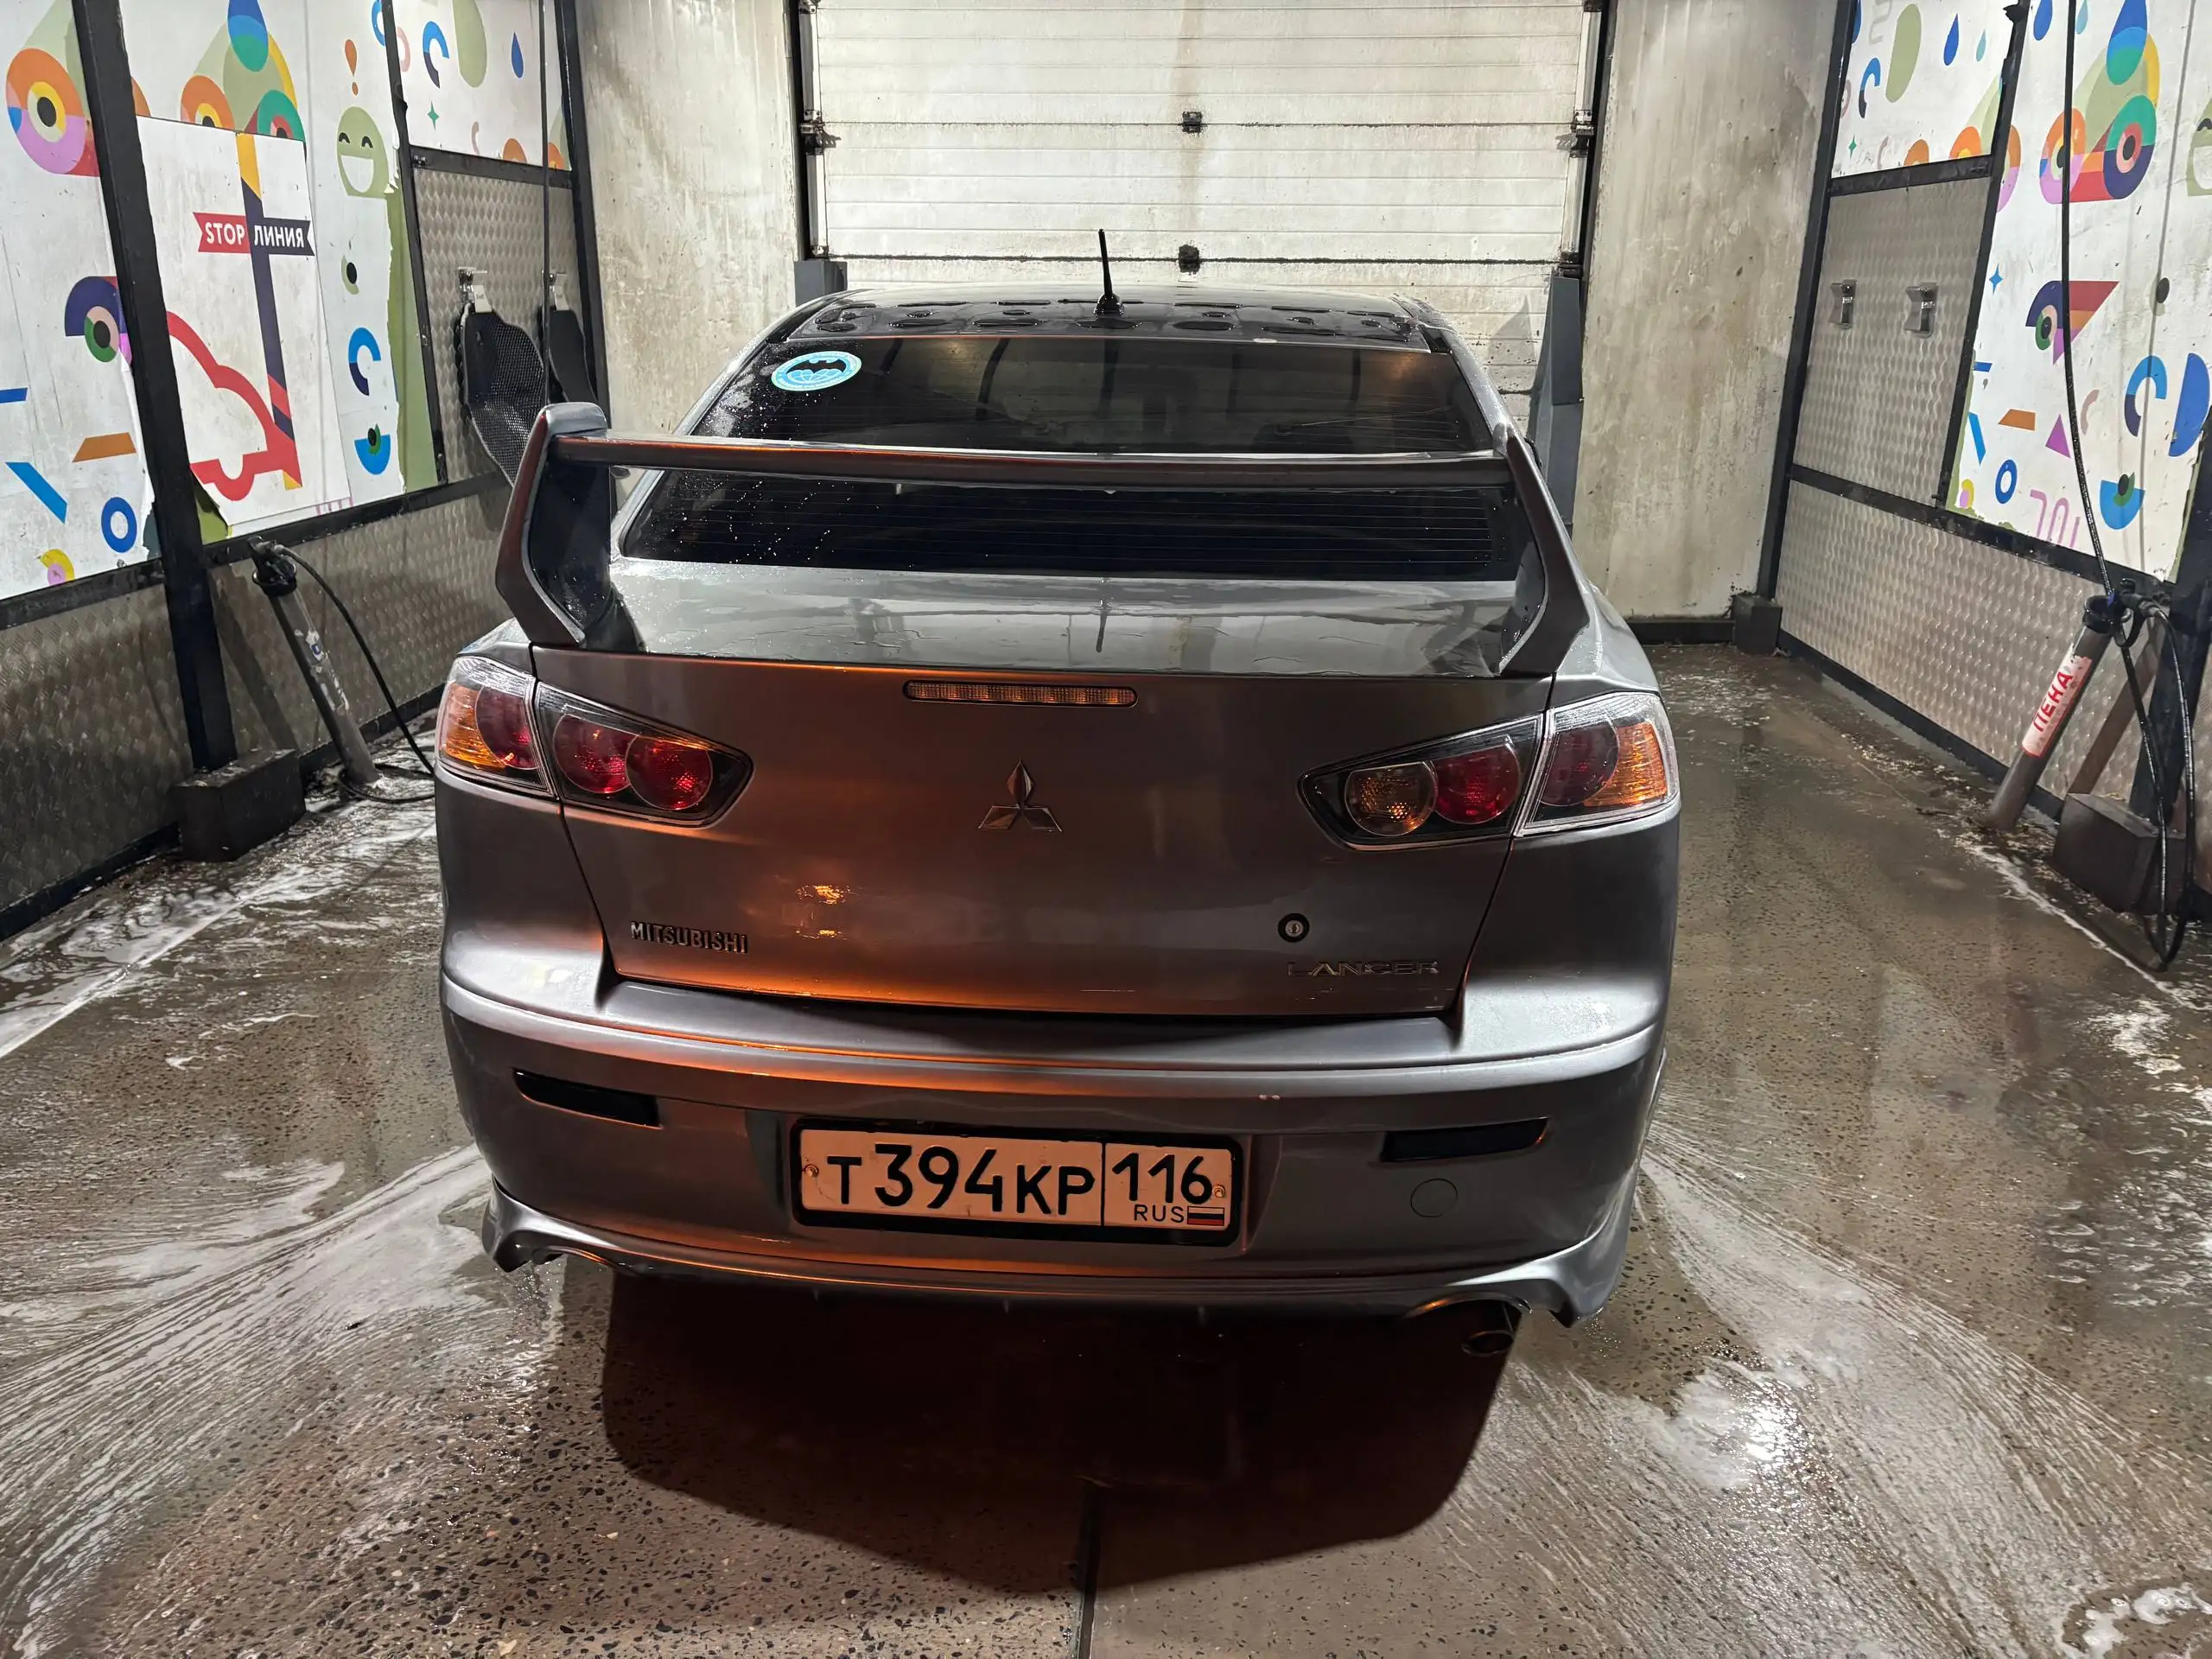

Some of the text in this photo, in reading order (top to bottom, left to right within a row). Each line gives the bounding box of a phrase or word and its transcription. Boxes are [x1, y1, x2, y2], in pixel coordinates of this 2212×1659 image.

[205, 222, 305, 248] STOP ЛИНИЯ
[2033, 671, 2073, 733] ПЕНА
[631, 921, 748, 954] MITSUBISHI
[1287, 961, 1440, 977] LANCER
[1111, 1152, 1213, 1205] 116
[1134, 1204, 1185, 1223] RUS
